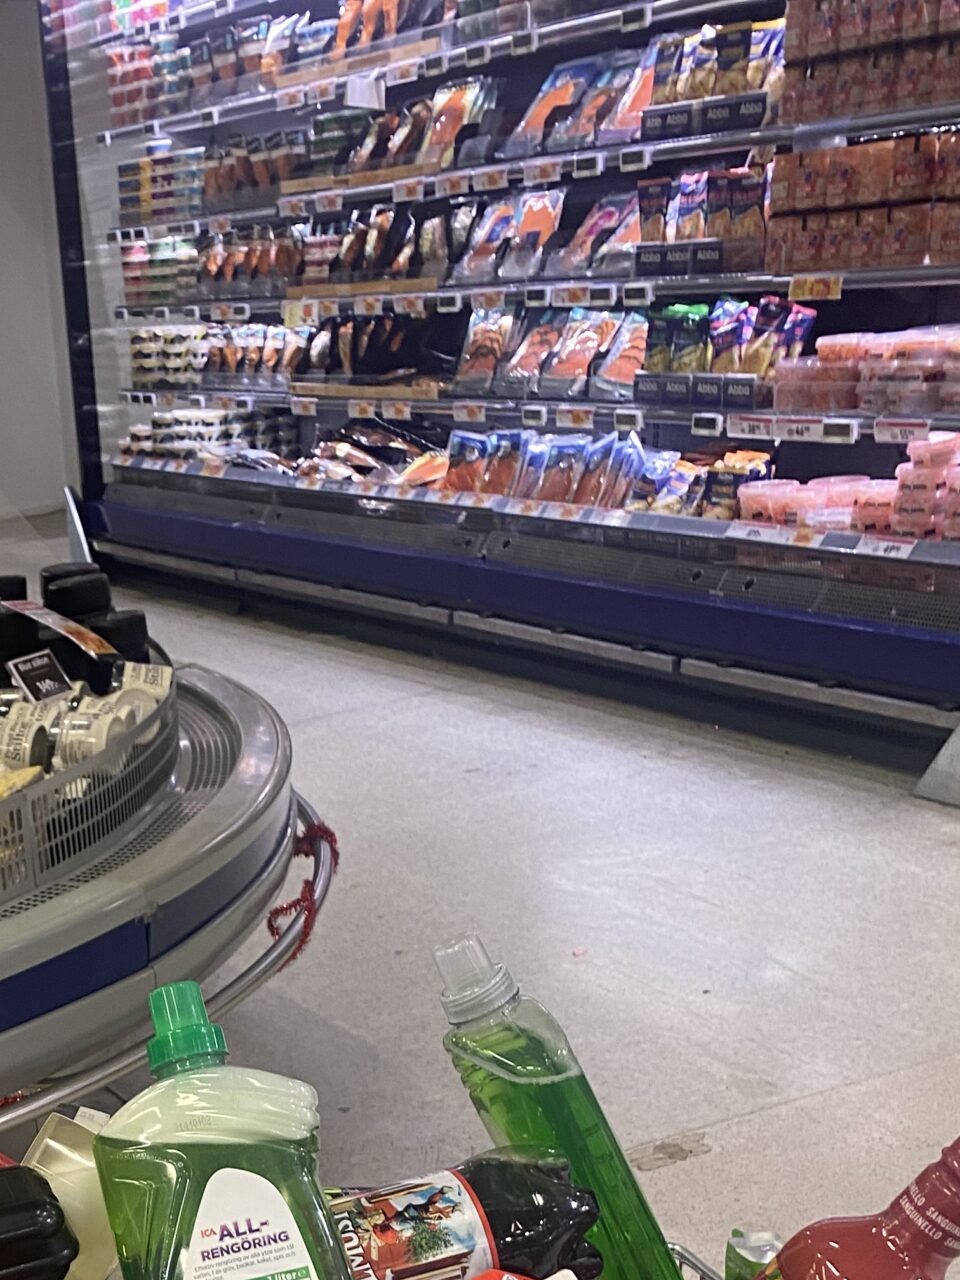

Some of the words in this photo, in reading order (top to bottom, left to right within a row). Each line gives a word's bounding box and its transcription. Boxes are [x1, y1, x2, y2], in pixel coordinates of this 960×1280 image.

[200, 1228, 217, 1239] ICA
[219, 1217, 269, 1242] ALL-
[899, 1194, 943, 1240] SANGUINELLO
[201, 1231, 290, 1262] RENGÖRING
